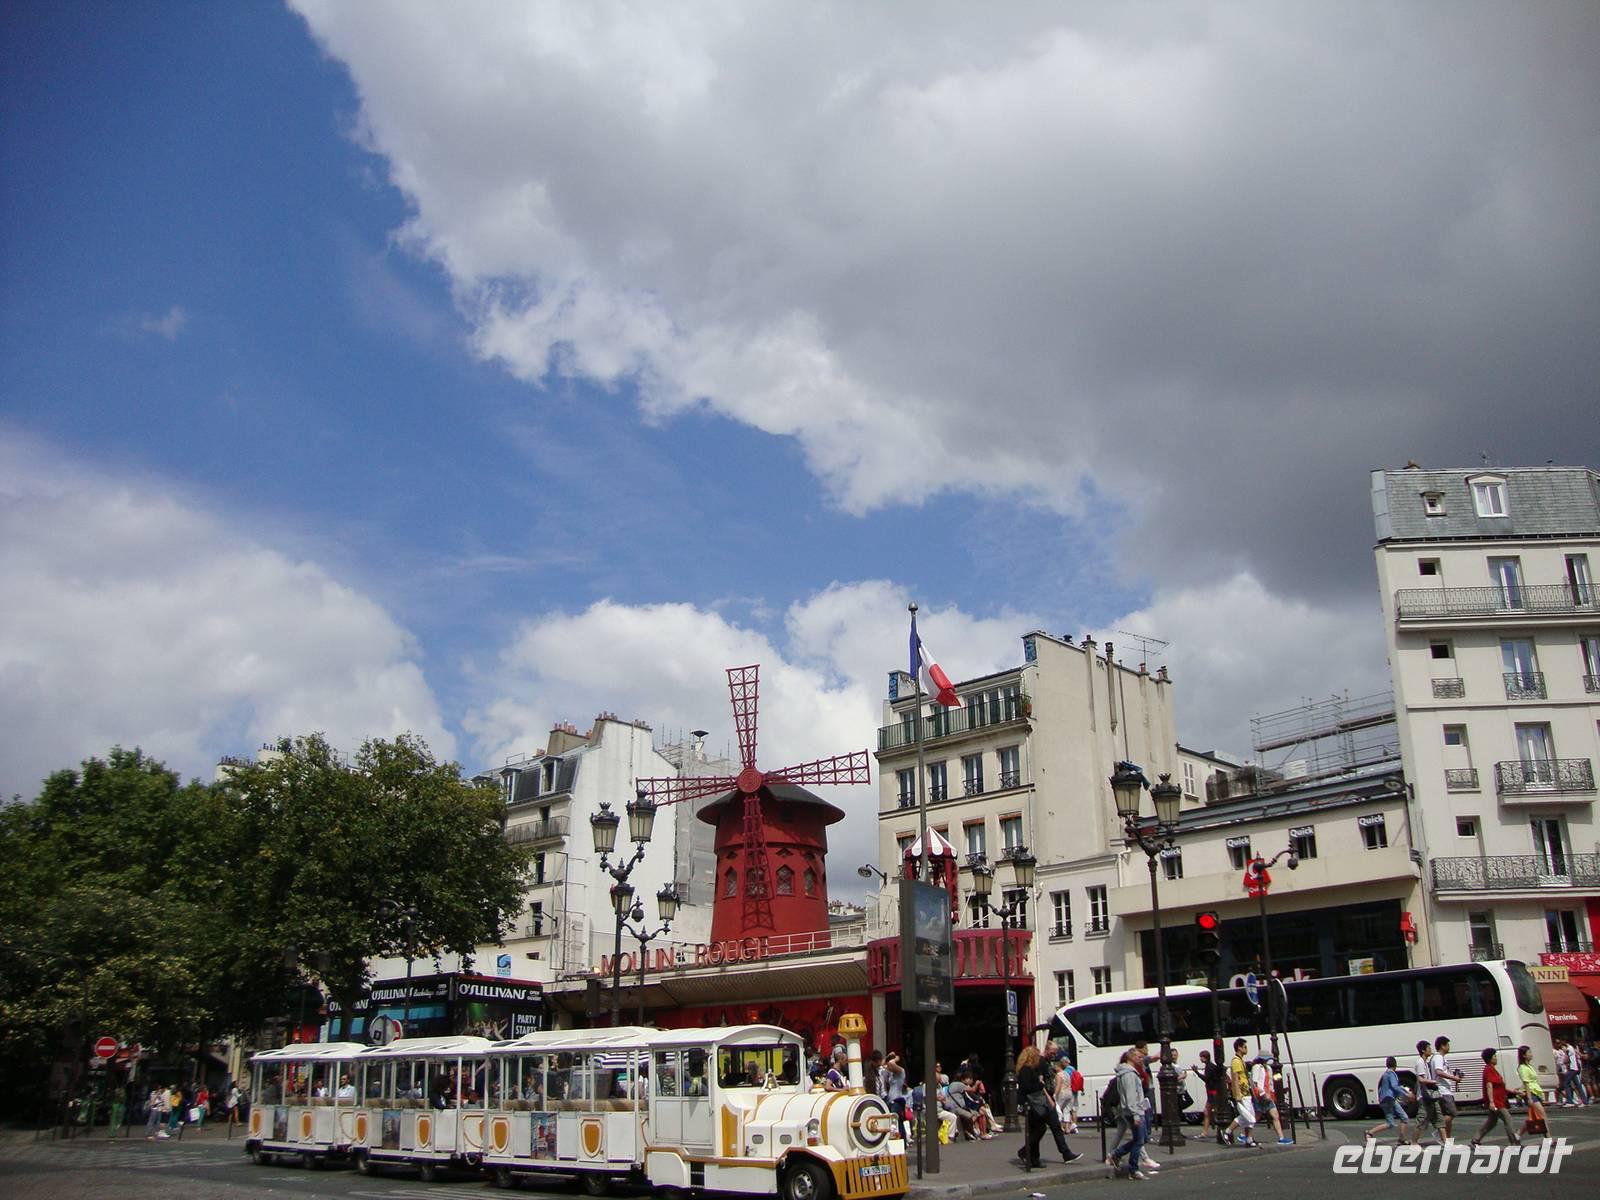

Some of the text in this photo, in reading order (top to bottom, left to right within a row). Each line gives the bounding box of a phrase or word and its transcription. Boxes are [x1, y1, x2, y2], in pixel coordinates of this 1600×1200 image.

[1360, 815, 1384, 826] Quick
[1290, 827, 1314, 837] Quick
[1227, 837, 1249, 847] Quick
[1160, 848, 1181, 858] Quick
[600, 936, 769, 976] MOULIN ROUGE
[459, 984, 526, 1000] O'SULLIVANS
[517, 1014, 537, 1024] PARTY
